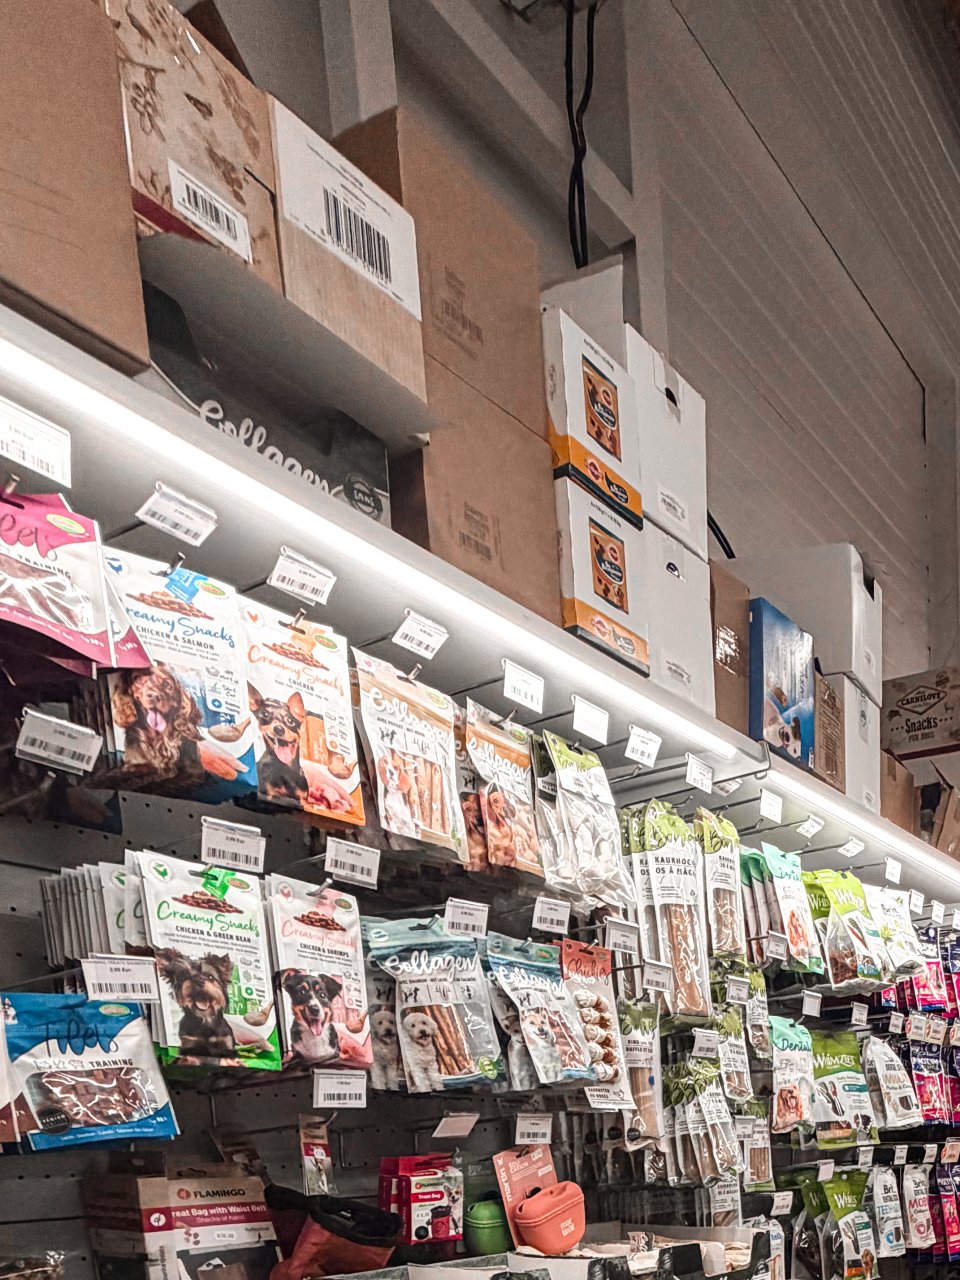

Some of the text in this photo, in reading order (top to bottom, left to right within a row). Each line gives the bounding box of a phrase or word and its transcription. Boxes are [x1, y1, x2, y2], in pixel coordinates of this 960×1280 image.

[17, 554, 71, 579] TRAINING
[125, 606, 176, 633] reamy
[177, 616, 236, 648] Snacks
[136, 625, 171, 640] CHICKEN
[173, 634, 179, 642] &
[181, 636, 215, 651] SALMON
[247, 644, 301, 679] Creamy
[301, 667, 345, 697] Snacks
[288, 677, 315, 692] CHICKEN
[901, 692, 941, 706] CARNILOVE
[905, 716, 938, 734] Snacks
[920, 731, 935, 740] DOGS
[156, 900, 260, 938] Creamy Snacks
[175, 924, 205, 936] CHICKEN
[206, 930, 212, 938] &
[213, 931, 235, 942] GREEN
[235, 933, 252, 944] BEAN
[281, 920, 324, 946] Creamy
[299, 942, 322, 953] CHICKEN
[326, 947, 350, 958] SHRIMPS
[383, 949, 479, 982] Collagen
[89, 1058, 134, 1069] TRAINING
[193, 1188, 246, 1199] FLAMINGO
[431, 1193, 441, 1201] Bag
[171, 1204, 266, 1218] reat Bag with Waist Belt
